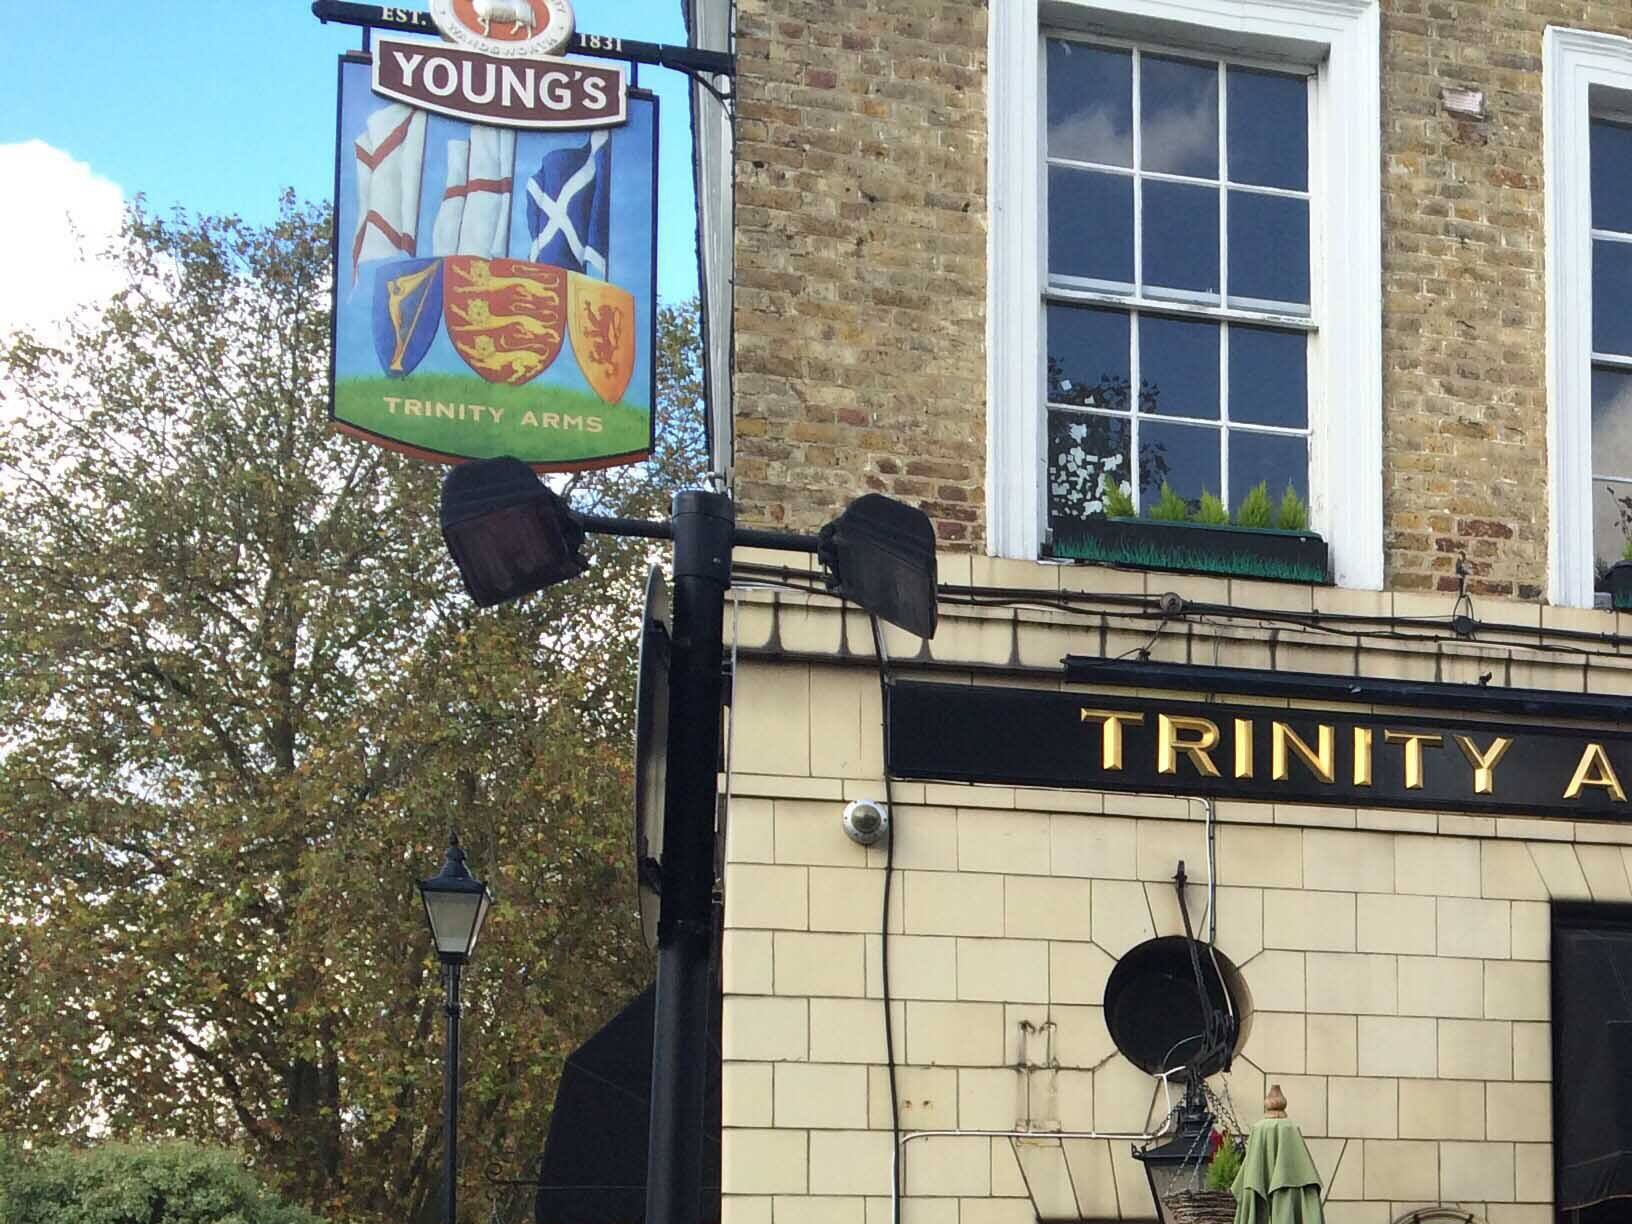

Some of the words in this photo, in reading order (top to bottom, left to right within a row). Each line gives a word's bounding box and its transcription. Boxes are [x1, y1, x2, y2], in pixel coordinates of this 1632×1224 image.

[381, 7, 427, 26] EST.
[579, 34, 623, 52] 1831
[392, 51, 608, 110] YOUNG'S
[383, 396, 505, 424] TRINITY
[521, 410, 604, 433] ARMS
[1080, 707, 1514, 794] TRINITY
